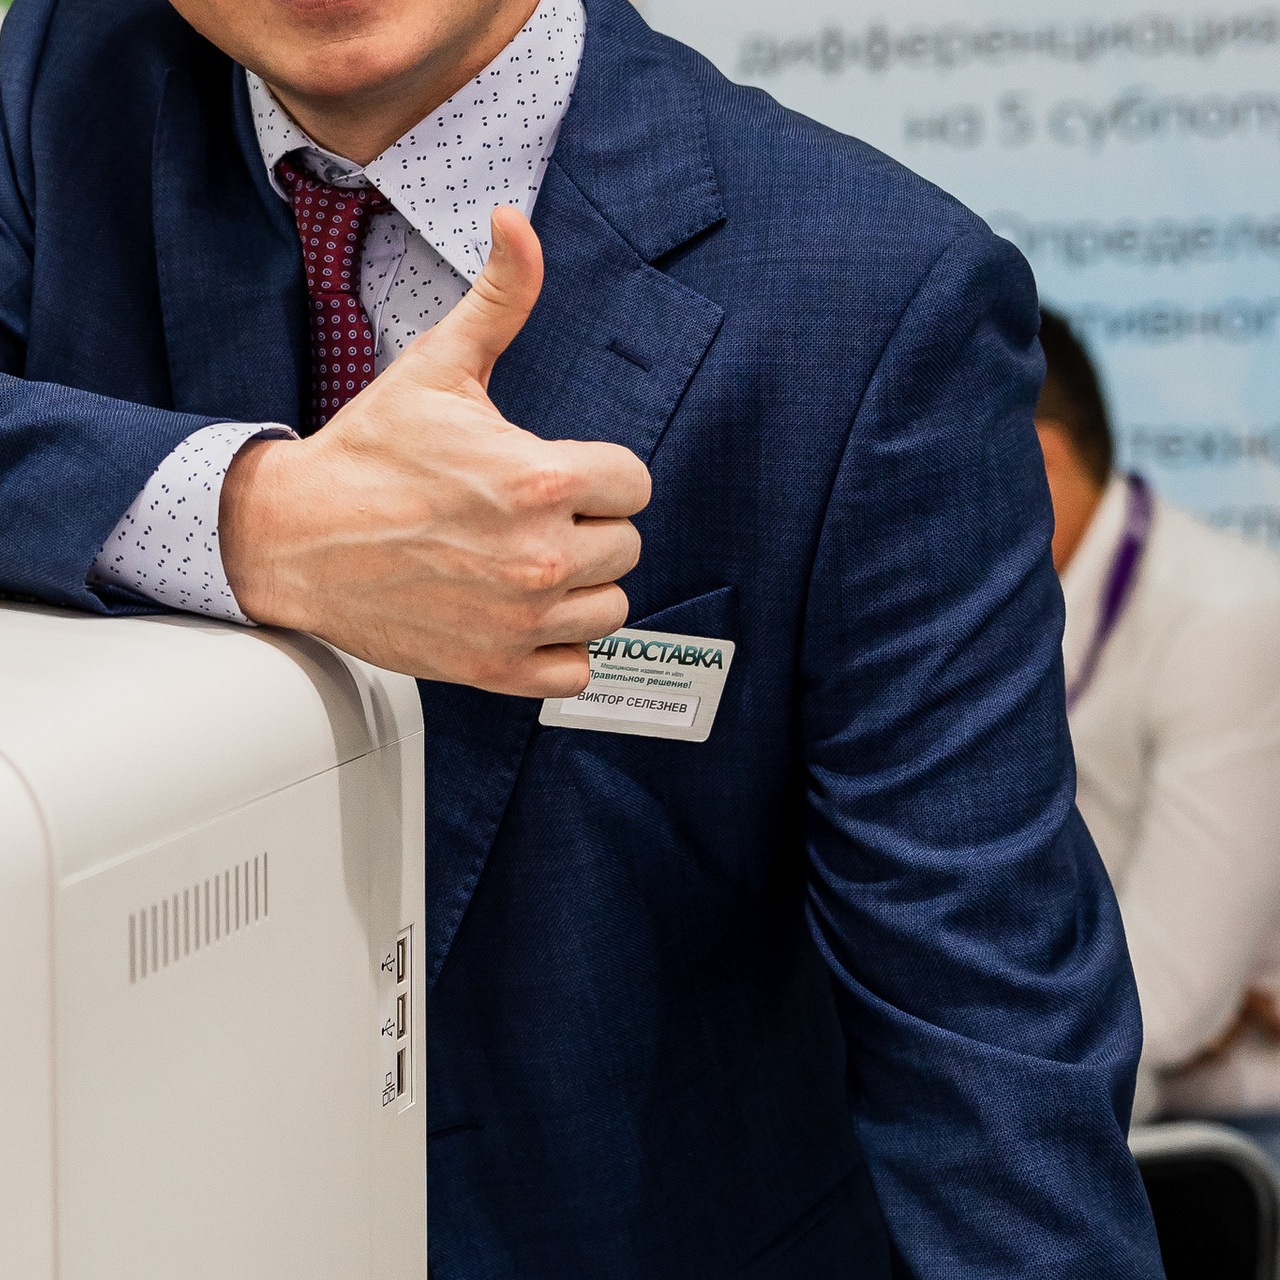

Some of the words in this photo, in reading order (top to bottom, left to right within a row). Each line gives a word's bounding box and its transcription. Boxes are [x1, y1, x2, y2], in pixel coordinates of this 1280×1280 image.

[587, 636, 723, 670] ЕДПОСТАВКА
[589, 670, 644, 684] Правильное
[646, 678, 692, 690] решение!
[577, 691, 624, 706] ВИКТОР
[627, 697, 688, 713] СЕЛЕЗНЕВ
